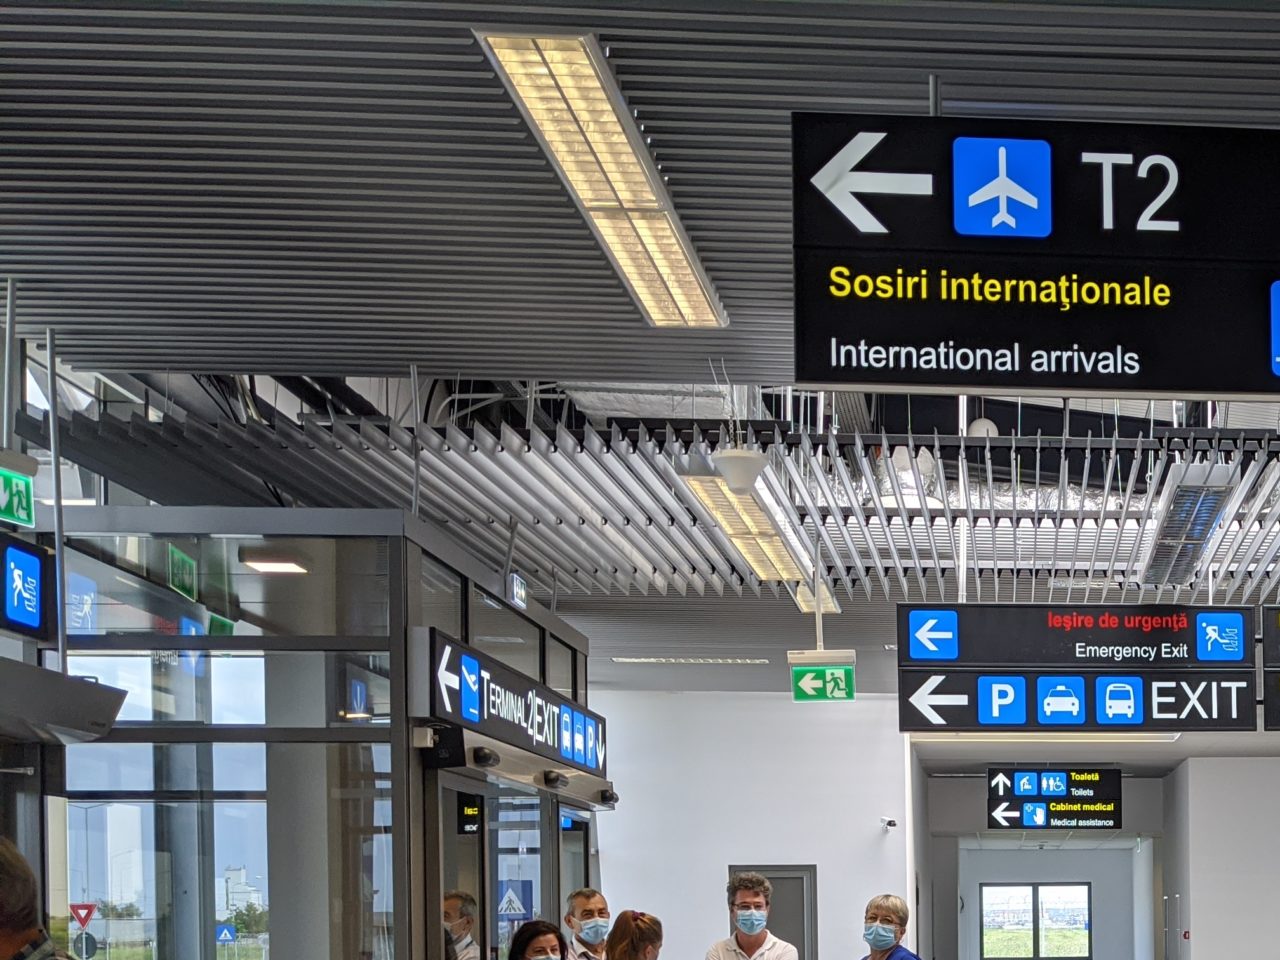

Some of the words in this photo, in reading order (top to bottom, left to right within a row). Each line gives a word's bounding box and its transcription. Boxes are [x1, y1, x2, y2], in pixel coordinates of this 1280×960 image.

[1081, 151, 1180, 232] T2
[829, 266, 927, 299] Sosiri
[831, 337, 1020, 372] International
[1030, 343, 1140, 375] arrivals
[1098, 612, 1120, 629] de
[1075, 642, 1157, 662] Emergency
[1161, 642, 1189, 658] Exit
[1151, 681, 1247, 719] EXIT
[1070, 772, 1100, 781] Toaletă
[1070, 787, 1094, 797] Toilets
[1049, 802, 1082, 811] Cabinet
[1082, 802, 1114, 811] medical
[1050, 818, 1077, 827] Medical
[1077, 818, 1114, 827] assistance
